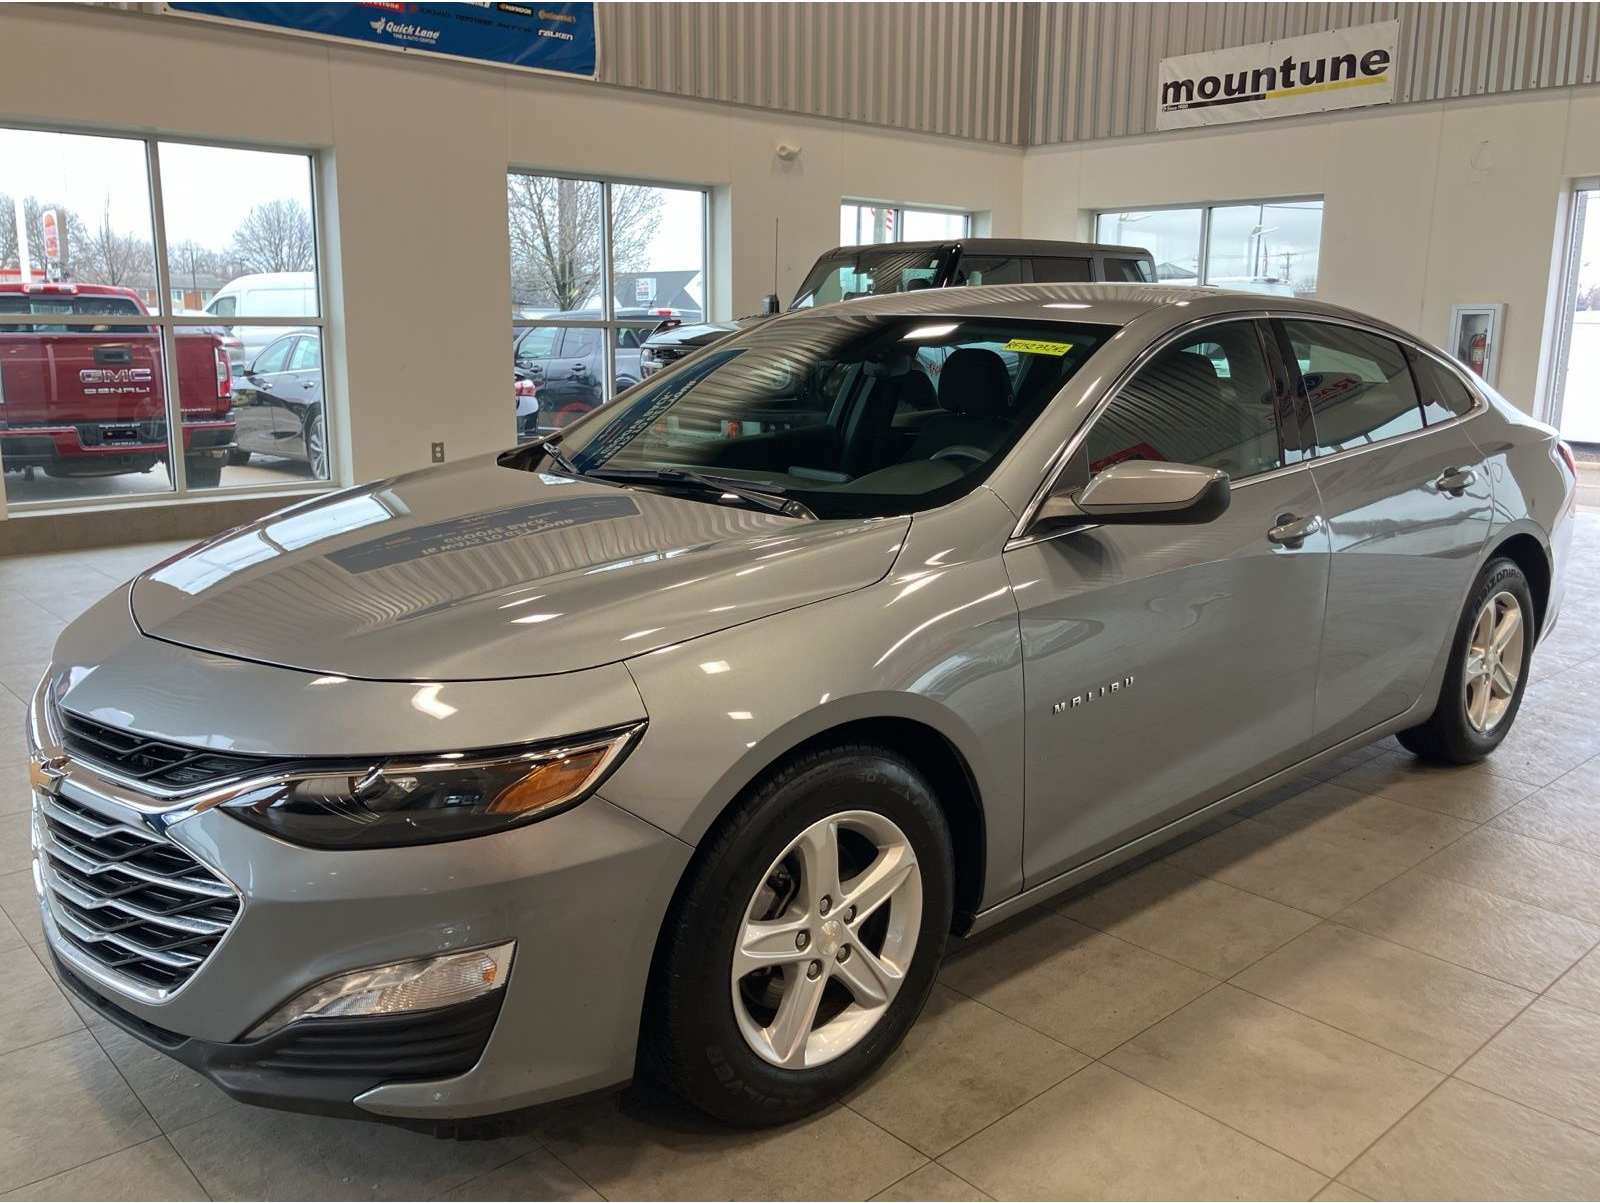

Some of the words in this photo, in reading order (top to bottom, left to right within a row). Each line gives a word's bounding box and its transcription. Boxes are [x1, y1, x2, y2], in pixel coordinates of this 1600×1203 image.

[386, 21, 414, 35] Quick
[415, 26, 440, 39] Lane
[1161, 49, 1390, 104] mountune
[80, 368, 152, 383] GMC
[84, 387, 150, 395] DENALI
[1053, 676, 1134, 715] MALIBU
